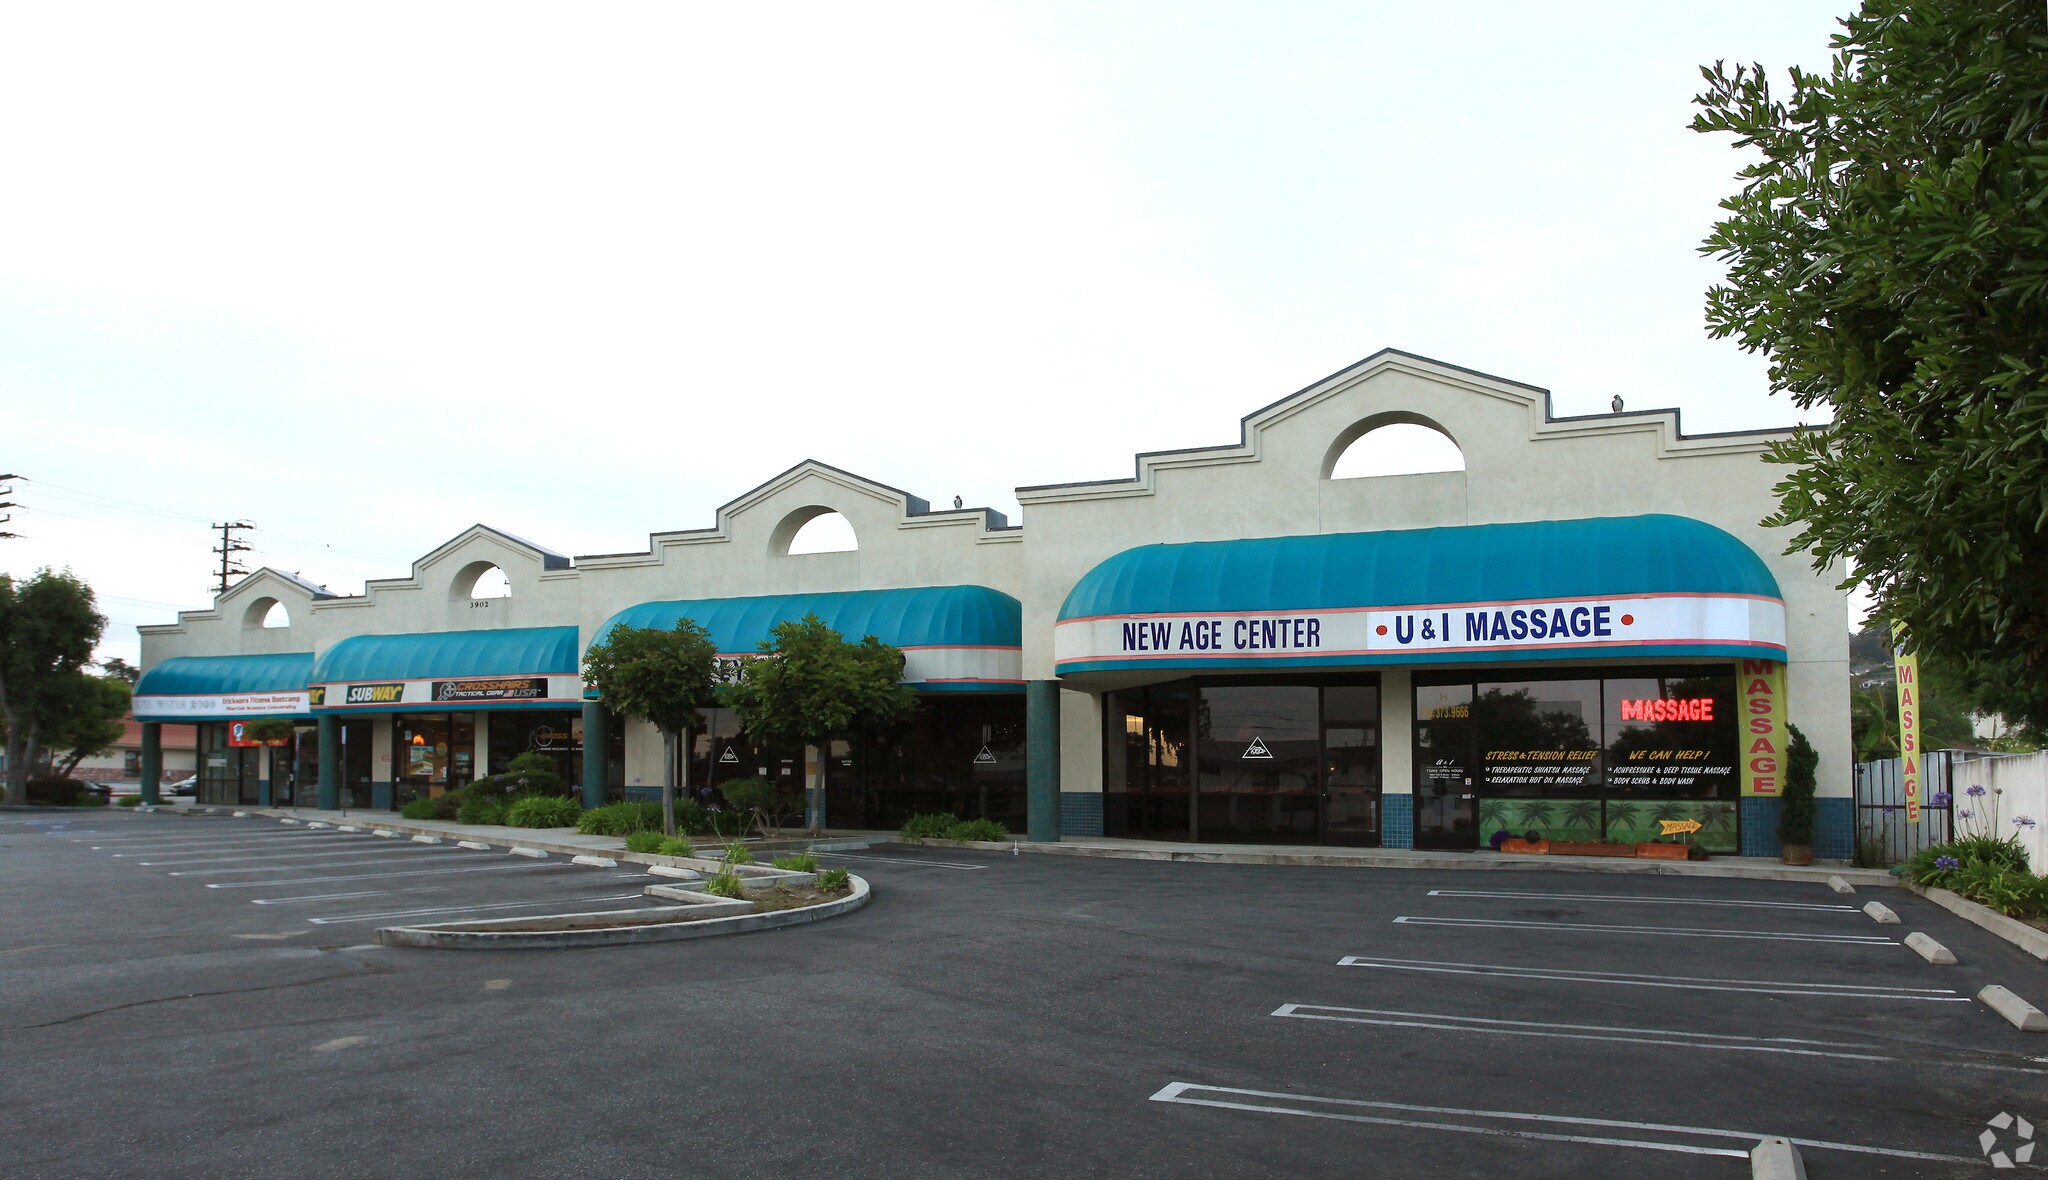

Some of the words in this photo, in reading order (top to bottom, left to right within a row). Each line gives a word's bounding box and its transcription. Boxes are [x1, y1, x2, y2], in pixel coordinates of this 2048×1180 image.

[1396, 615, 1414, 644] U
[1421, 618, 1436, 640] &
[1442, 613, 1449, 641] I
[1466, 605, 1612, 642] MASSAGE
[1123, 622, 1172, 650] NEW
[1179, 620, 1222, 650] AGE
[1234, 618, 1320, 649] CENTER
[456, 680, 530, 691] CROSSHAIRS
[348, 685, 403, 702] SUBWAY
[513, 689, 538, 697] USA
[190, 700, 216, 709] 2000
[1621, 698, 1714, 722] MASSAGE
[1743, 659, 1777, 793] MASSAGE
[1898, 664, 1917, 820] MASSAGE
[1485, 751, 1520, 760] STRESS
[1527, 750, 1566, 760] TENSION
[1567, 750, 1598, 760] RELIEF
[1629, 750, 1647, 760] WE
[1649, 750, 1673, 760] CAN
[1491, 766, 1532, 774] THERAPEUTIC
[1533, 766, 1561, 774] SHIATSU
[1562, 766, 1591, 775] MASSAGE
[1613, 766, 1655, 774] ACUPRESSURE
[1663, 766, 1679, 774] DEEP
[1680, 766, 1702, 774] TISSUE
[1703, 766, 1732, 776] MASSAGE
[1491, 776, 1528, 784] RELAXATION
[1555, 776, 1584, 785] MASSAGE
[1613, 777, 1631, 785] BODY
[1631, 777, 1650, 785] SCRUB
[1659, 777, 1676, 785] BODY
[1676, 777, 1695, 785] WASH
[1665, 821, 1697, 831] MASSAGE
